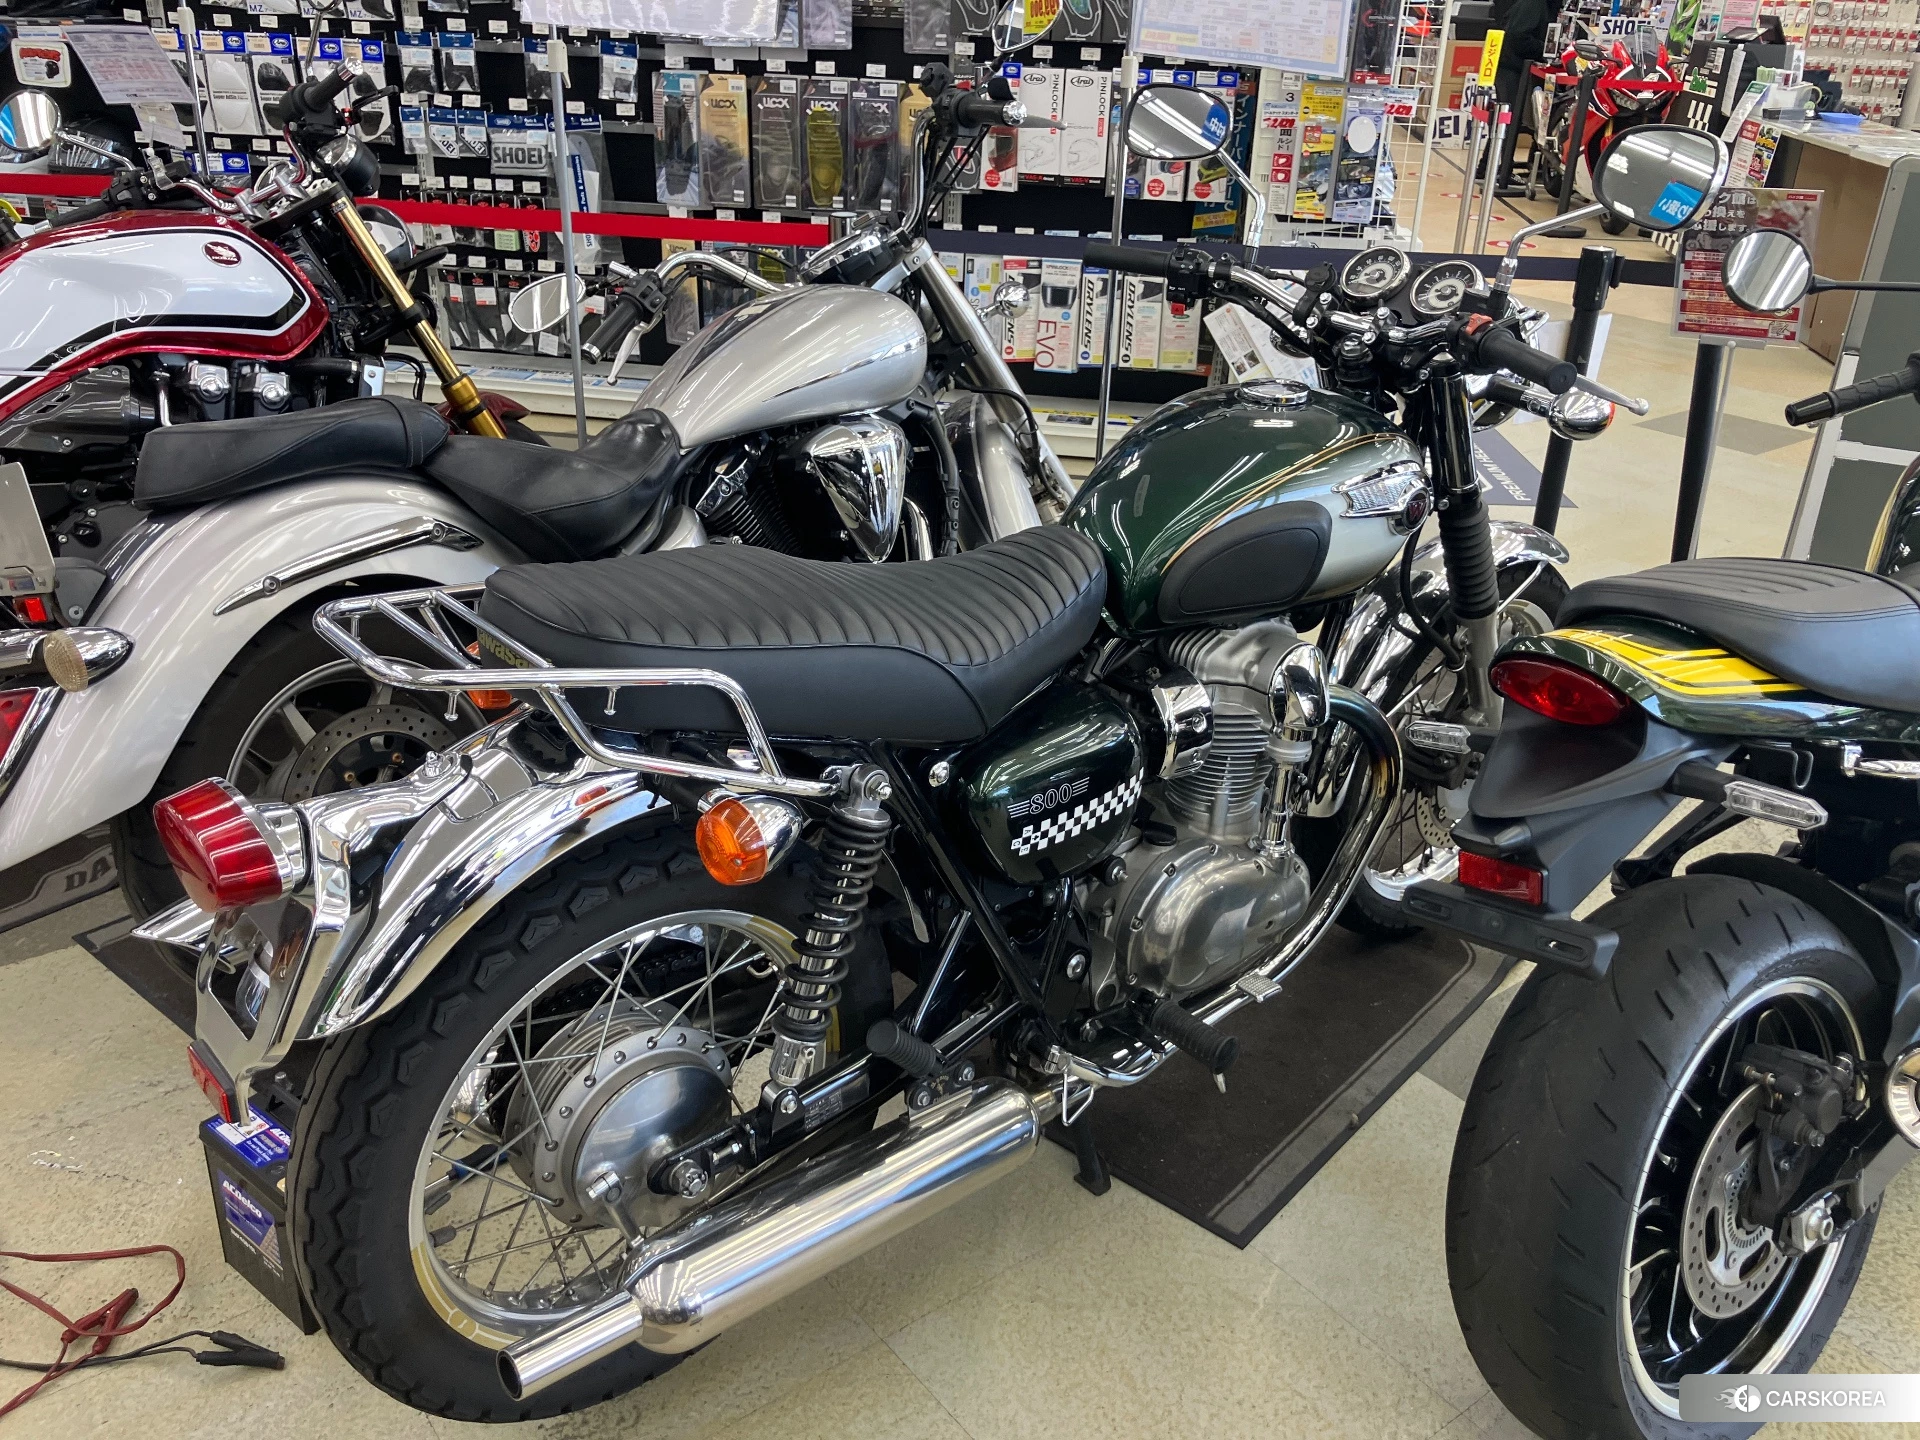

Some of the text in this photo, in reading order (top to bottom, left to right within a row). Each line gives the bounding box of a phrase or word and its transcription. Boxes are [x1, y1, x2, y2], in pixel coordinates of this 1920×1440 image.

[1602, 19, 1651, 35] SHO
[1483, 39, 1497, 77] レジ入口
[1051, 73, 1060, 114] PINLOCK
[1098, 76, 1107, 117] PINLOCK
[493, 147, 544, 165] SHOEI
[1719, 192, 1757, 206] ク館は
[1084, 279, 1095, 349] DRYLENS
[1125, 281, 1136, 352] DRYLENS
[1035, 319, 1057, 368] EVO
[1029, 783, 1073, 815] 800
[222, 1179, 263, 1219] ACDelco
